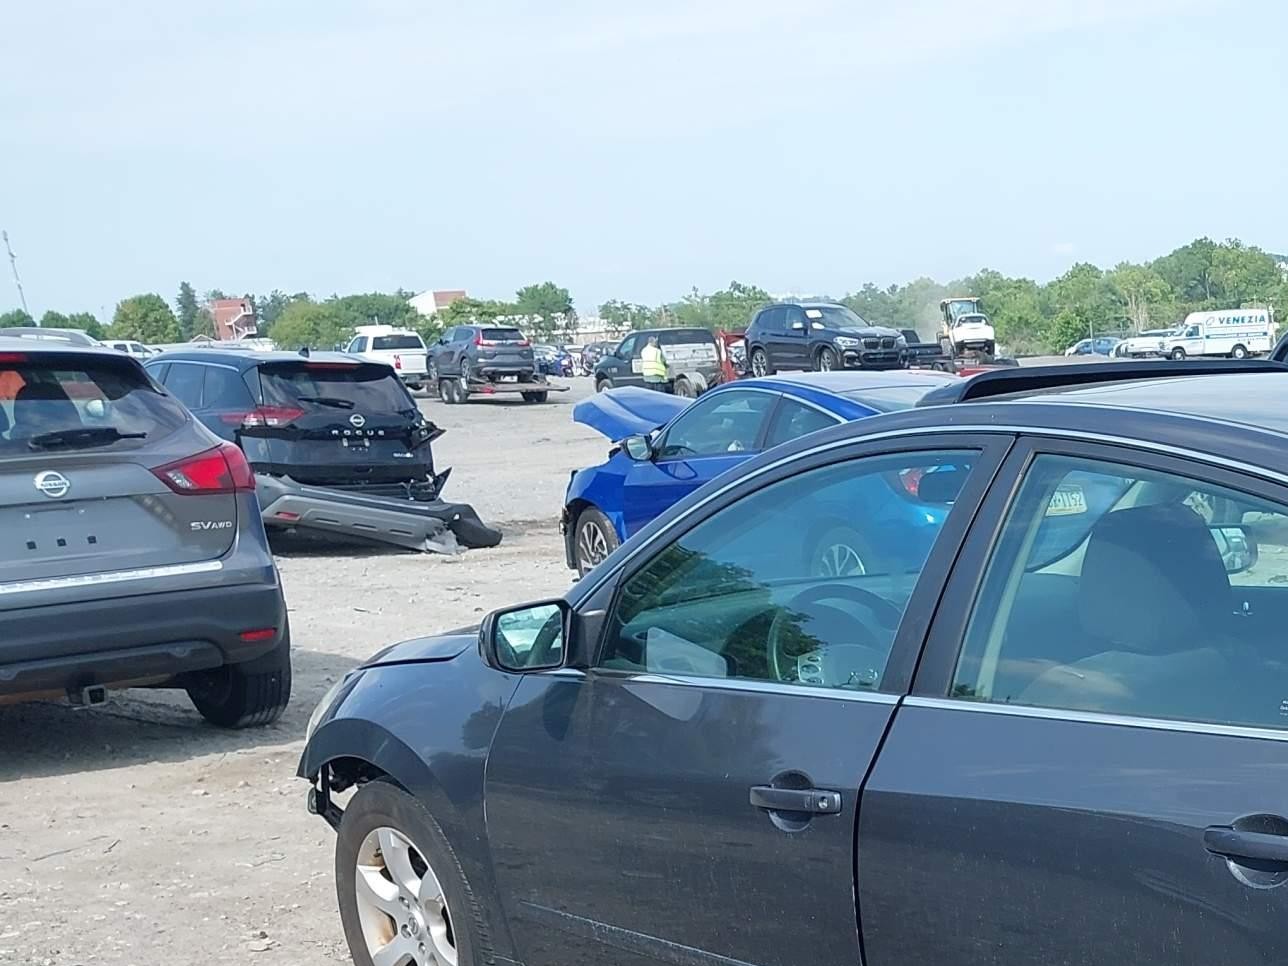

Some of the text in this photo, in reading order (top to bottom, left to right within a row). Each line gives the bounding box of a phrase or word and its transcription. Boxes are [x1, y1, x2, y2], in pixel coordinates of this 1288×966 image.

[1218, 314, 1266, 325] VENEZIA
[190, 520, 233, 530] SV AWD
